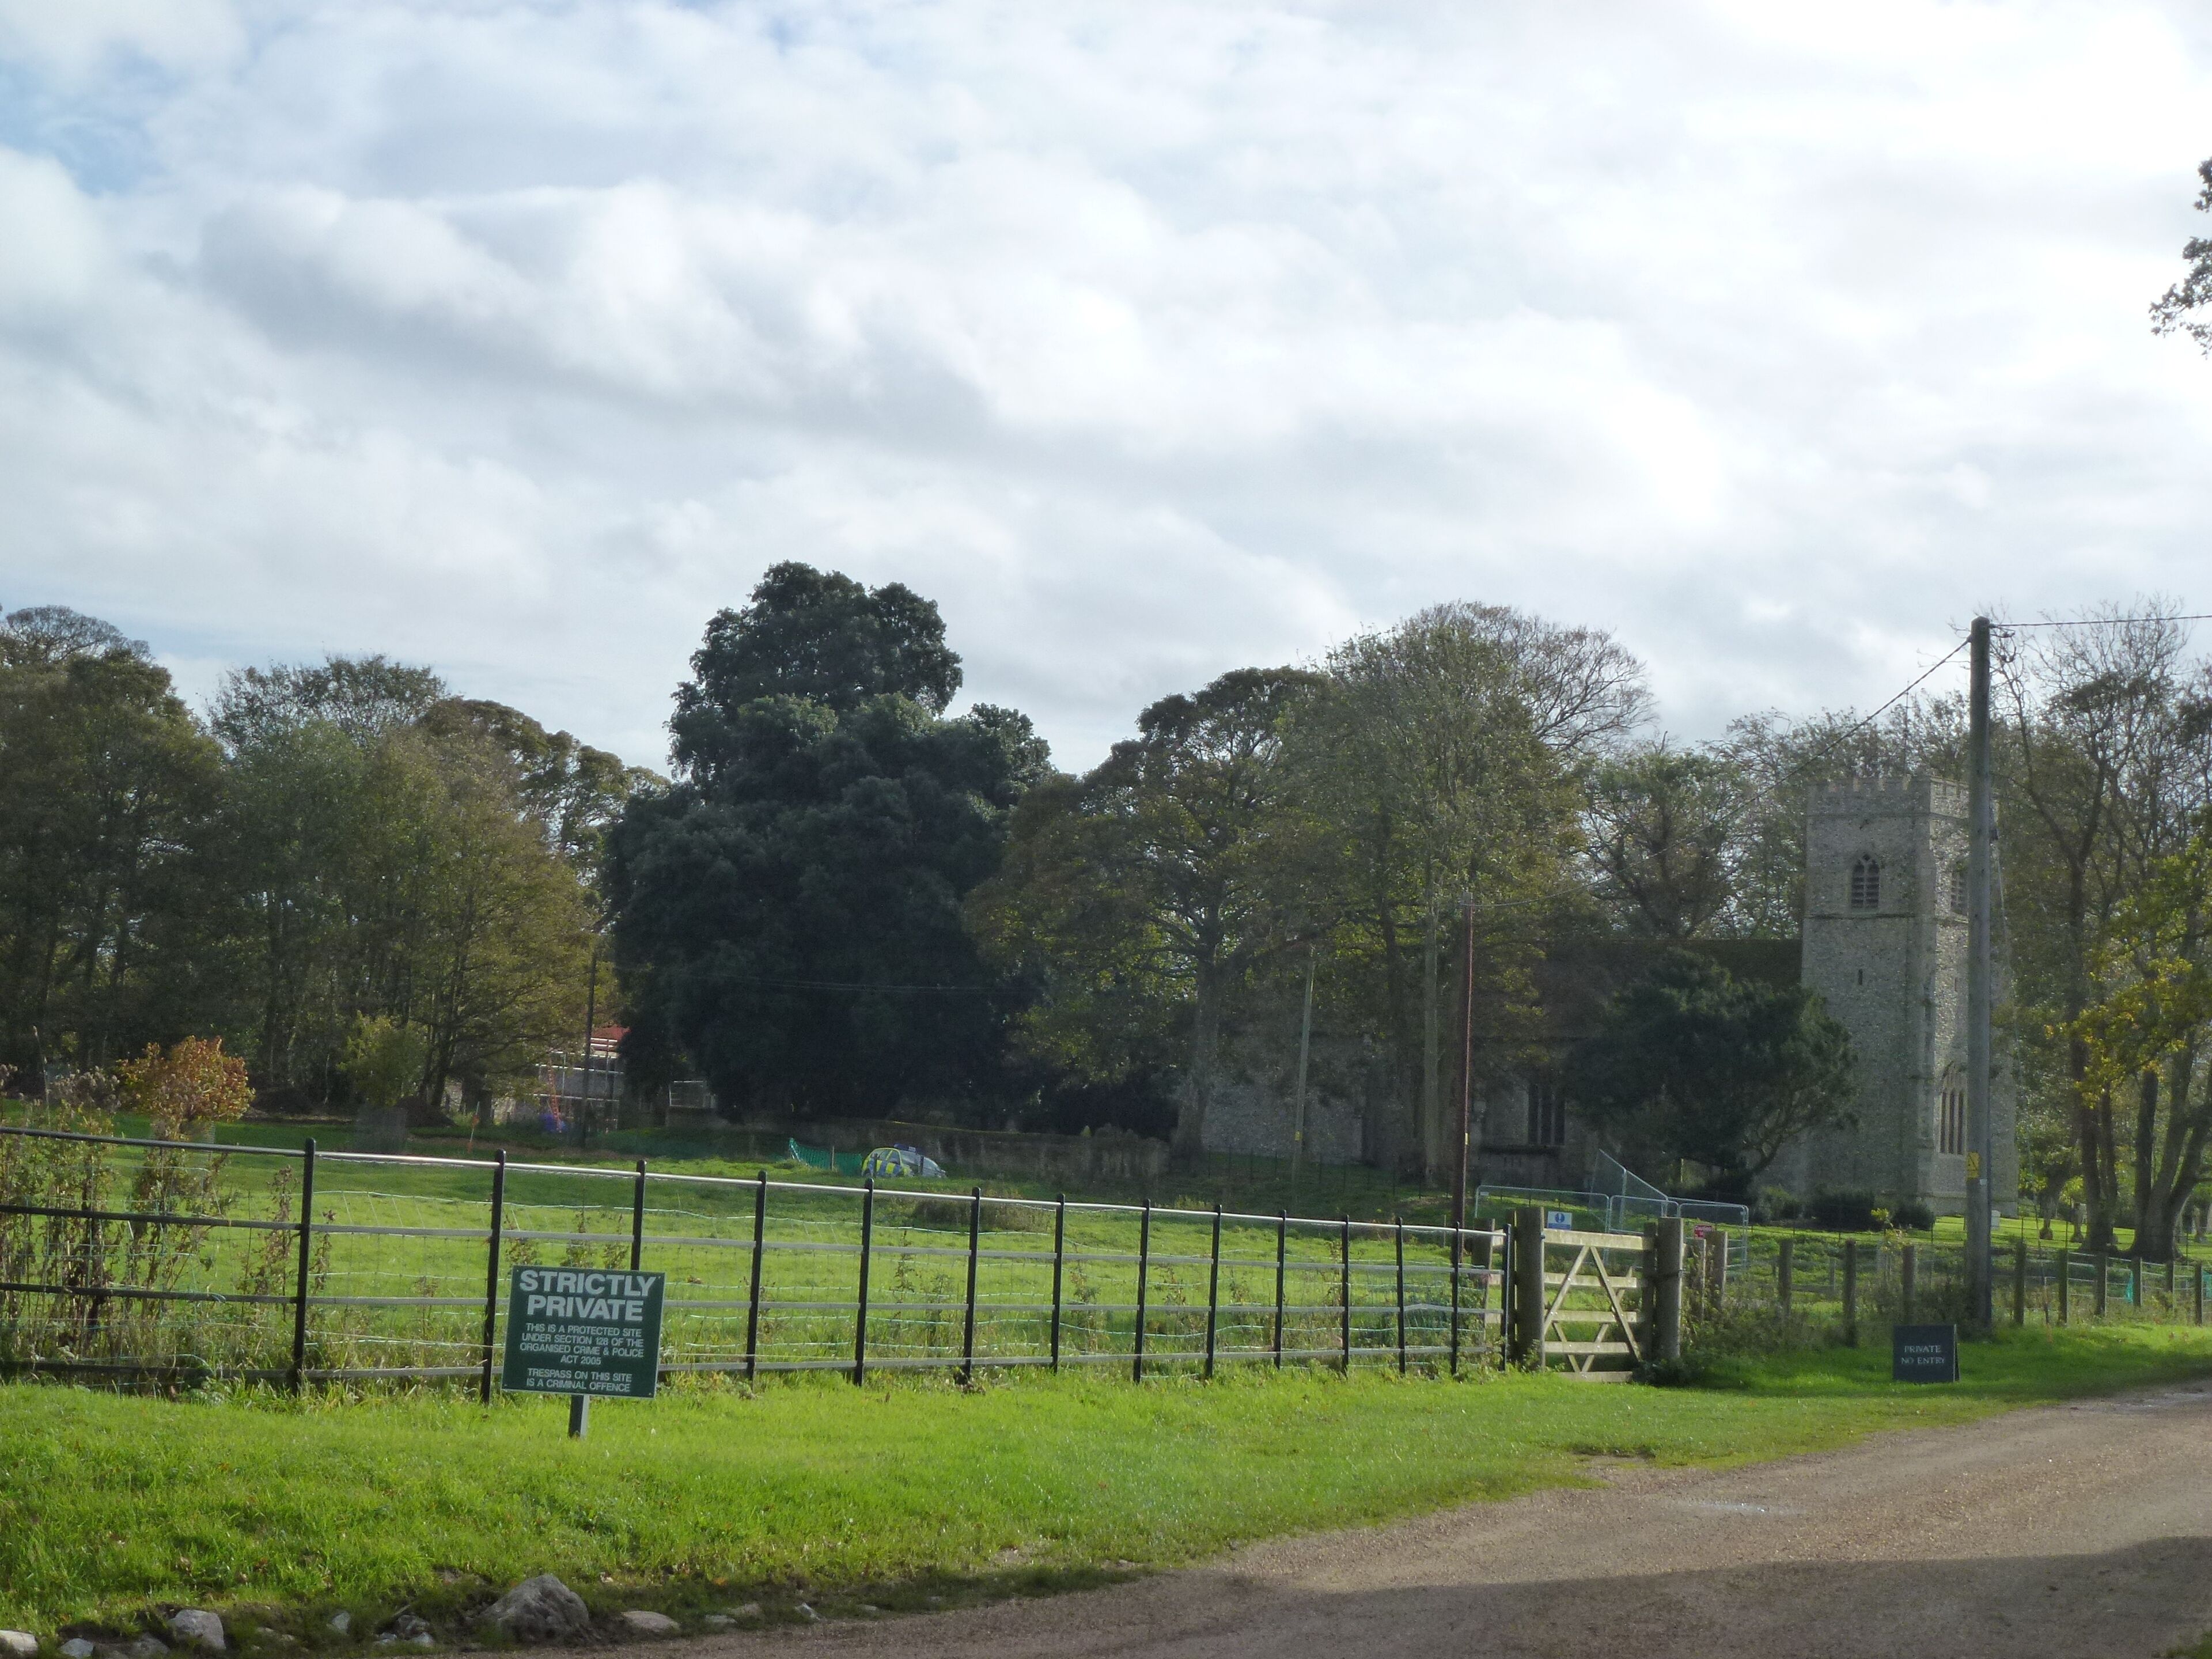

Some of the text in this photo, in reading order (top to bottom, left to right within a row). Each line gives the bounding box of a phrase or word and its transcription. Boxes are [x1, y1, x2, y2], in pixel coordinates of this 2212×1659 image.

[520, 1270, 656, 1296] STRICTLY
[527, 1295, 643, 1321] PRIVATE
[526, 1323, 642, 1337] THIS IS A PROTECTED SITE
[522, 1333, 644, 1347] UNDER SECTION 128 OF THE
[520, 1342, 571, 1353] ORGANISED
[573, 1345, 600, 1355] CRIME
[612, 1347, 644, 1357] POLICE
[560, 1354, 601, 1365] ACT 2005
[528, 1368, 632, 1382] TRESPASS ON THIS SITE
[527, 1378, 535, 1387] IS
[547, 1379, 586, 1389] CRIMINAL
[589, 1382, 631, 1392] OFFENCE
